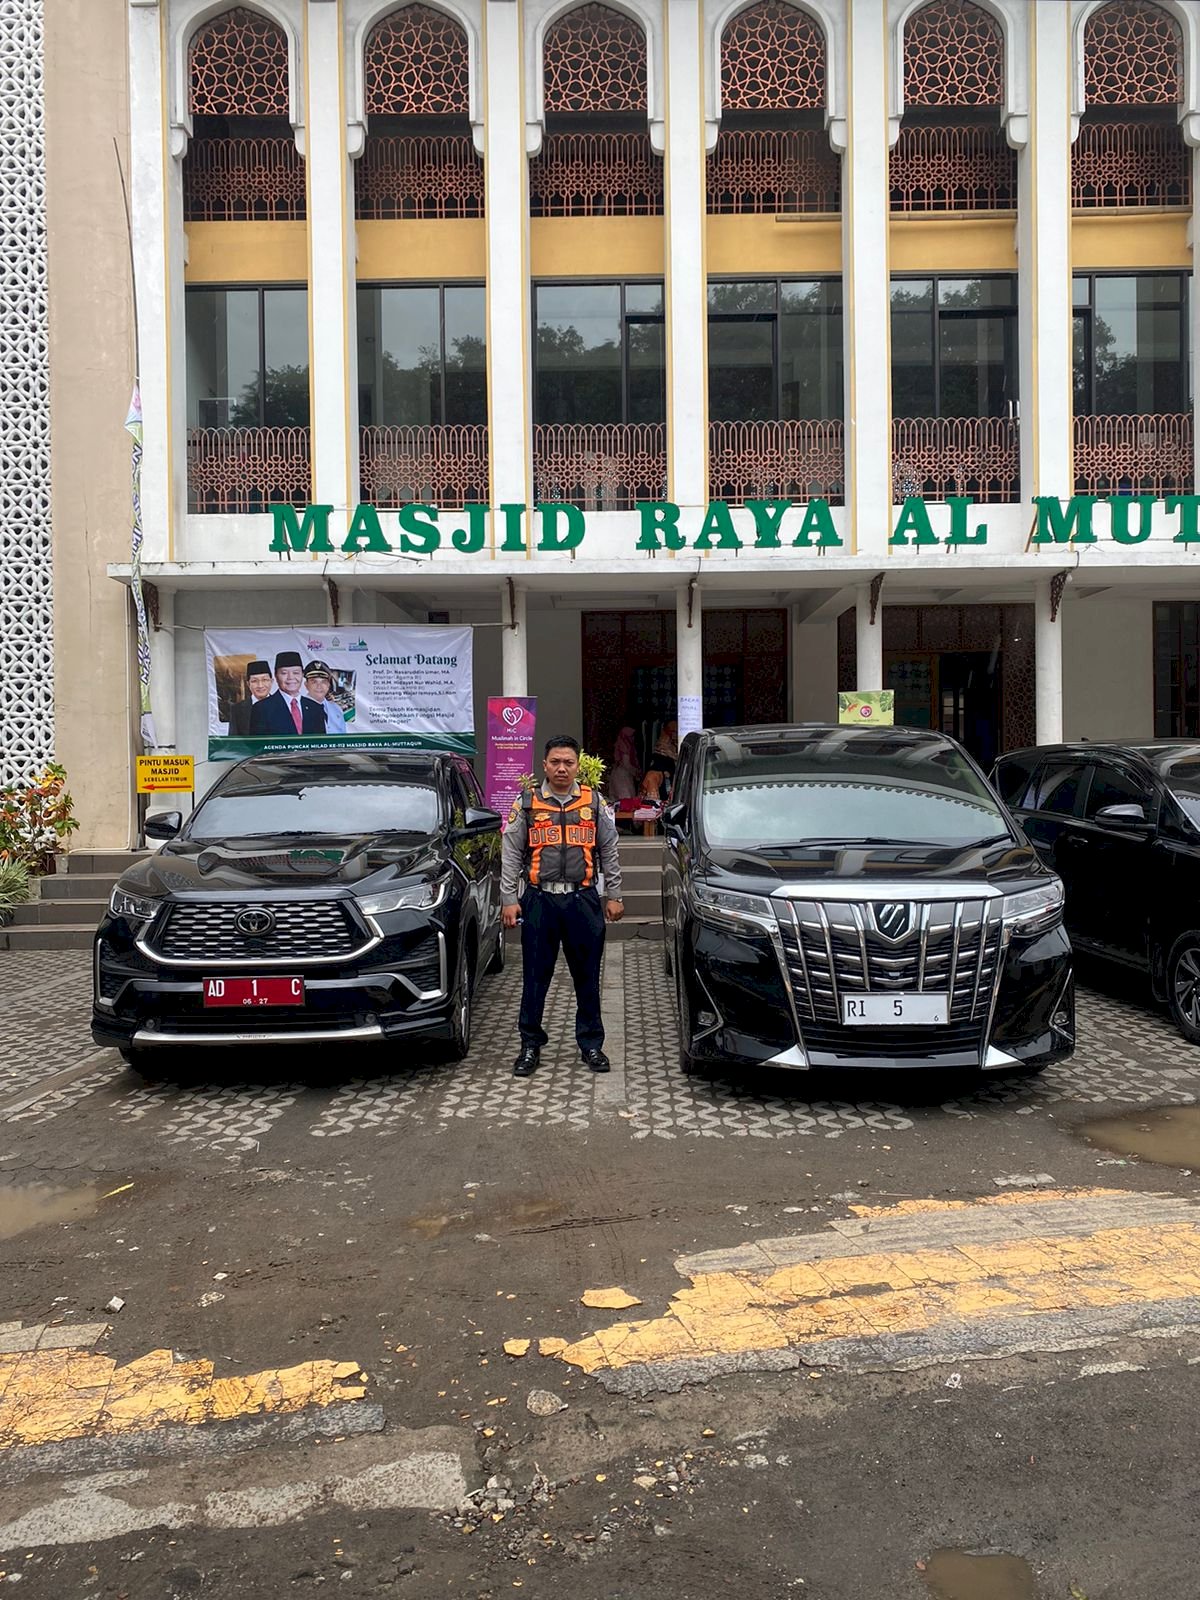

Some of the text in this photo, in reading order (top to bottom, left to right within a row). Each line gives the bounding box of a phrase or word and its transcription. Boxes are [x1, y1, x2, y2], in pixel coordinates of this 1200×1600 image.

[268, 503, 586, 553] MASJID
[635, 498, 844, 550] RAYA
[888, 496, 988, 545] AL
[365, 653, 458, 668] Selamat Datang
[162, 758, 190, 766] MASUK
[530, 827, 594, 844] DIS HUB
[207, 978, 301, 997] AD 1 C
[847, 1000, 866, 1017] RI
[893, 999, 903, 1017] 5
